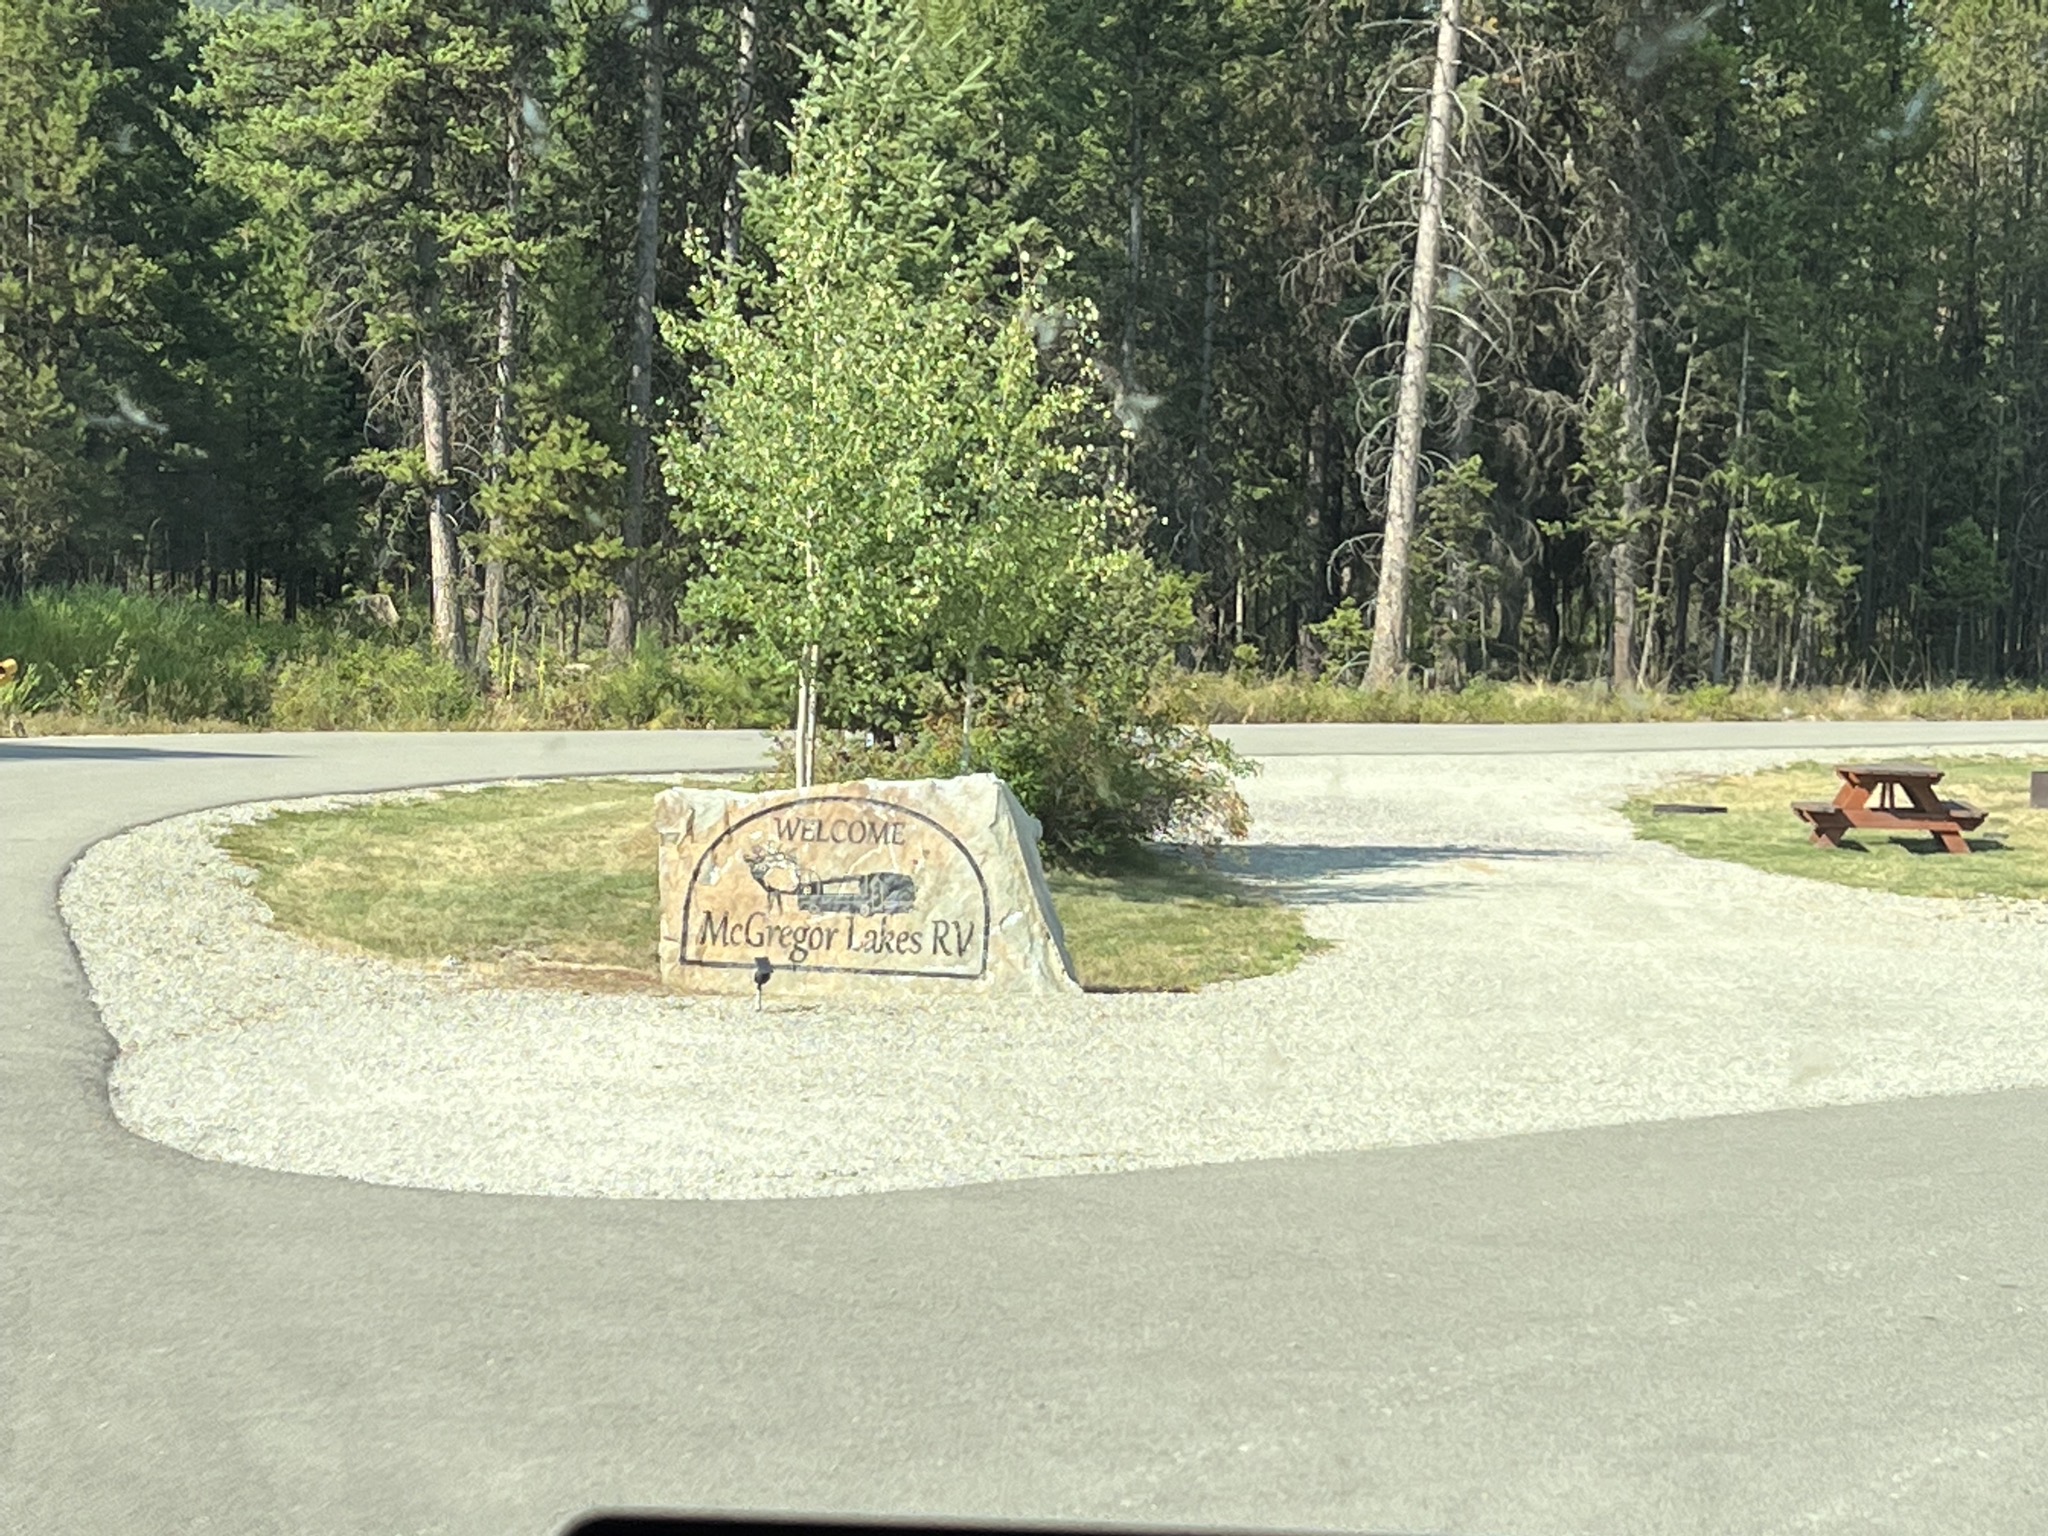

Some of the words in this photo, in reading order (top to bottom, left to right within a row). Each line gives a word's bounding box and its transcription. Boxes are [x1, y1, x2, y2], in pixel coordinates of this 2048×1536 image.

[774, 817, 906, 846] WELCOME
[699, 910, 839, 961] McGregor
[846, 917, 923, 954] Lakes
[932, 919, 975, 958] RV
